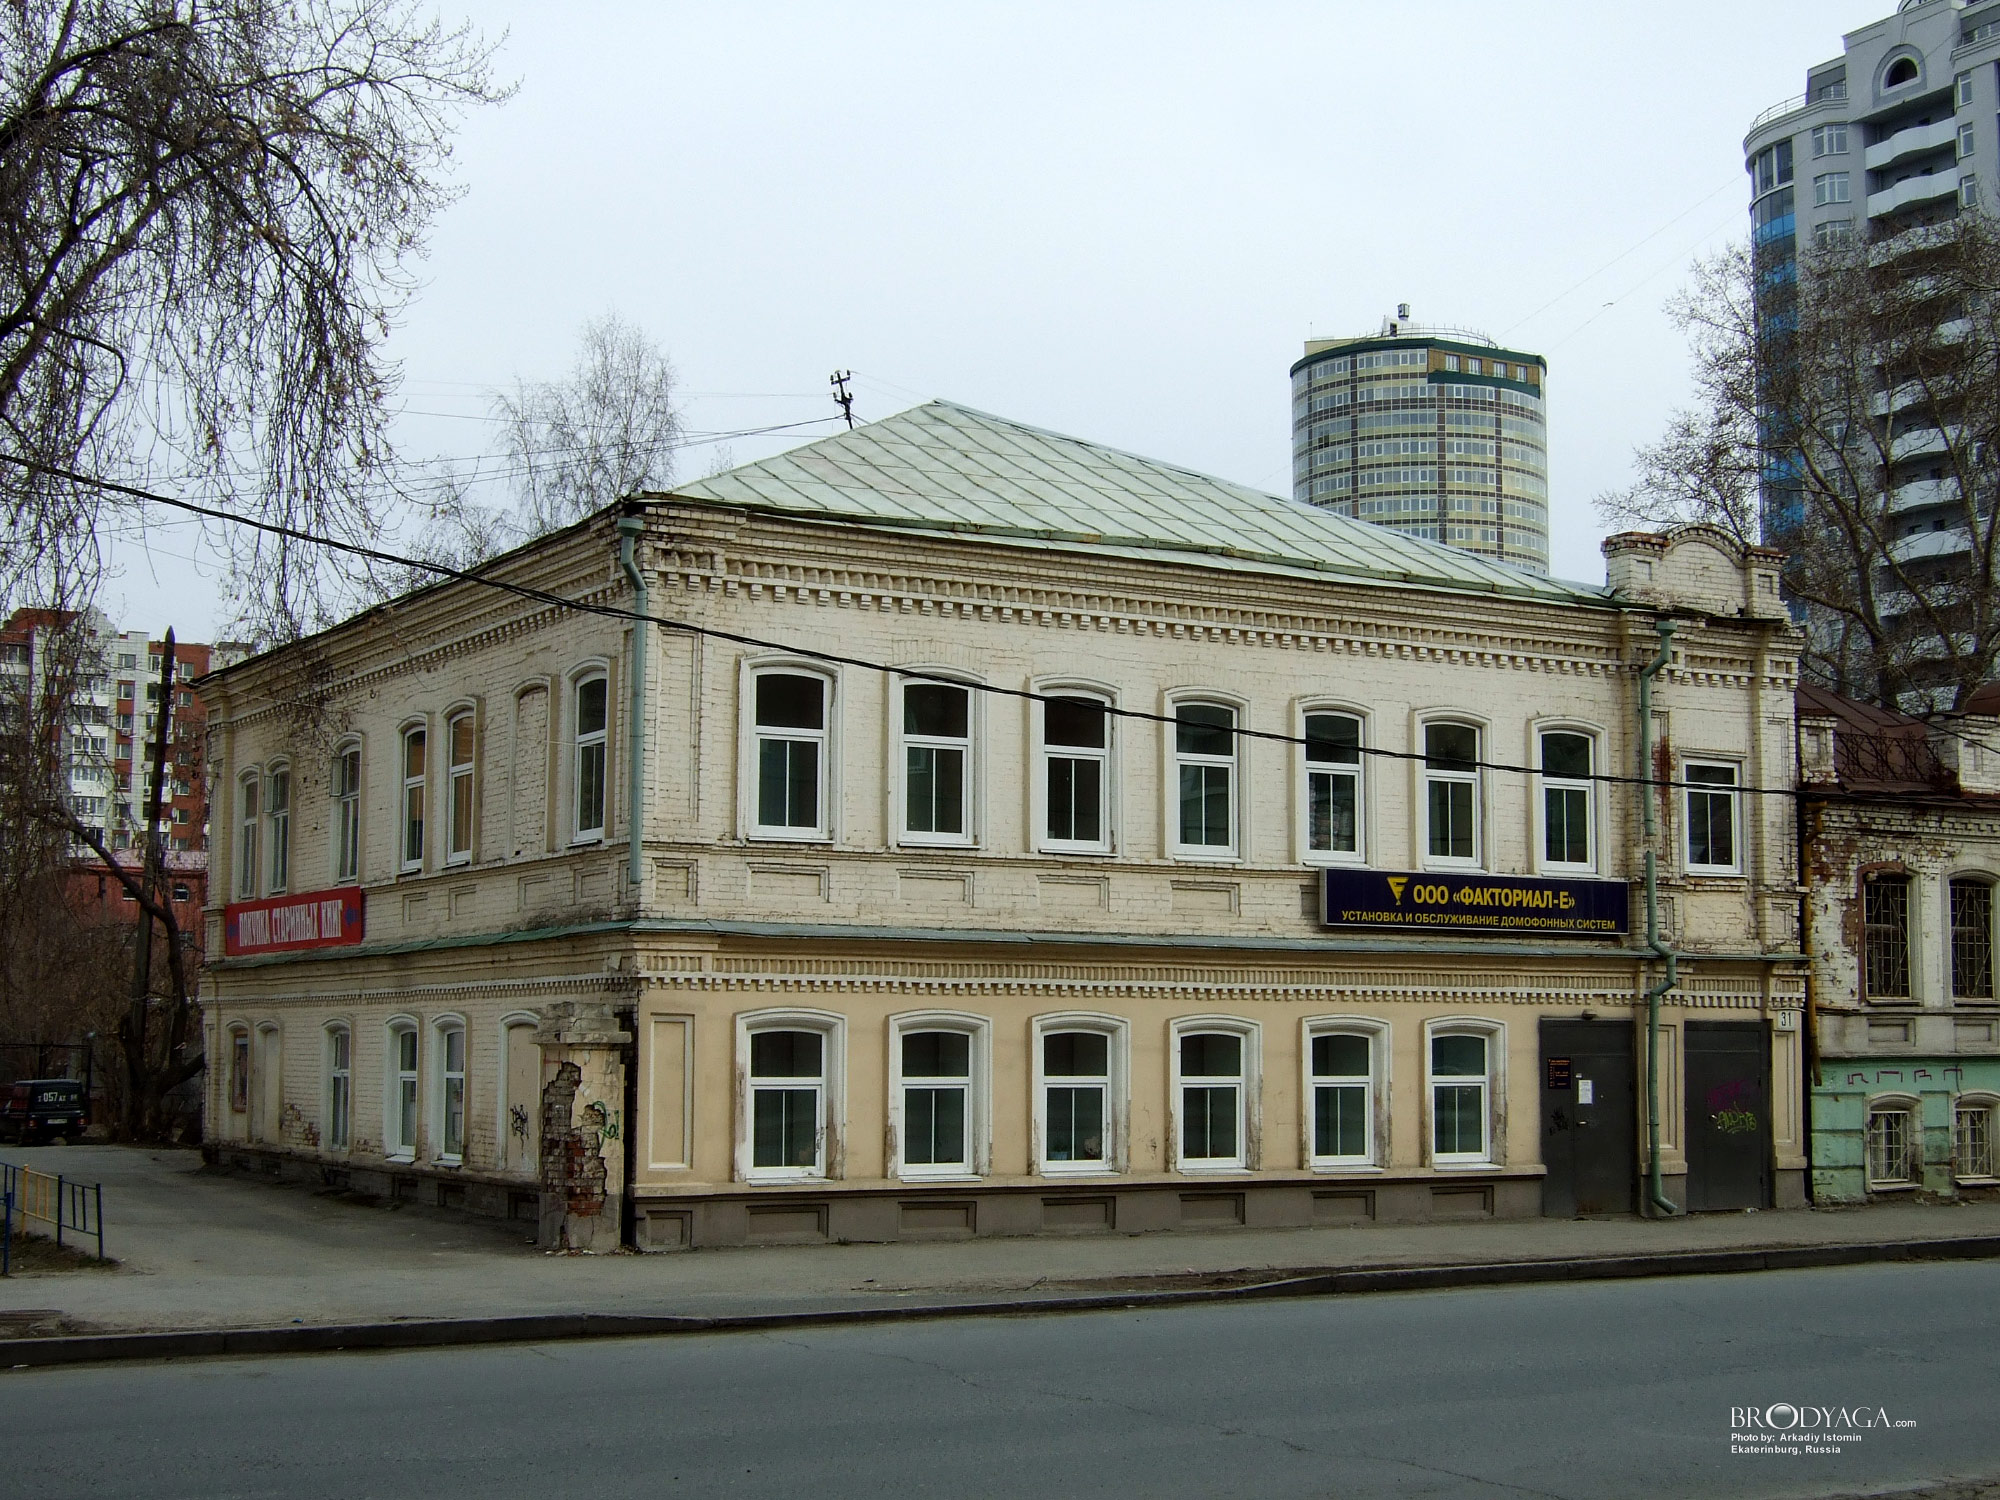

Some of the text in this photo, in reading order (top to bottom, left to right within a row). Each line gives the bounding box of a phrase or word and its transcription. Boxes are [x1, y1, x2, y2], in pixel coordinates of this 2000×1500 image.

[1413, 884, 1576, 910] ООО «ФАКТОРИАЛ-Е»
[239, 900, 342, 946] ПОКУПКА СТАРИННЫХ КНИГ
[1342, 910, 1616, 930] УСТАНОВКА И ОБСЛУЖИВАНИЕ ДОМОФОННЫХ СИСТЕМ
[1781, 1011, 1792, 1027] 31
